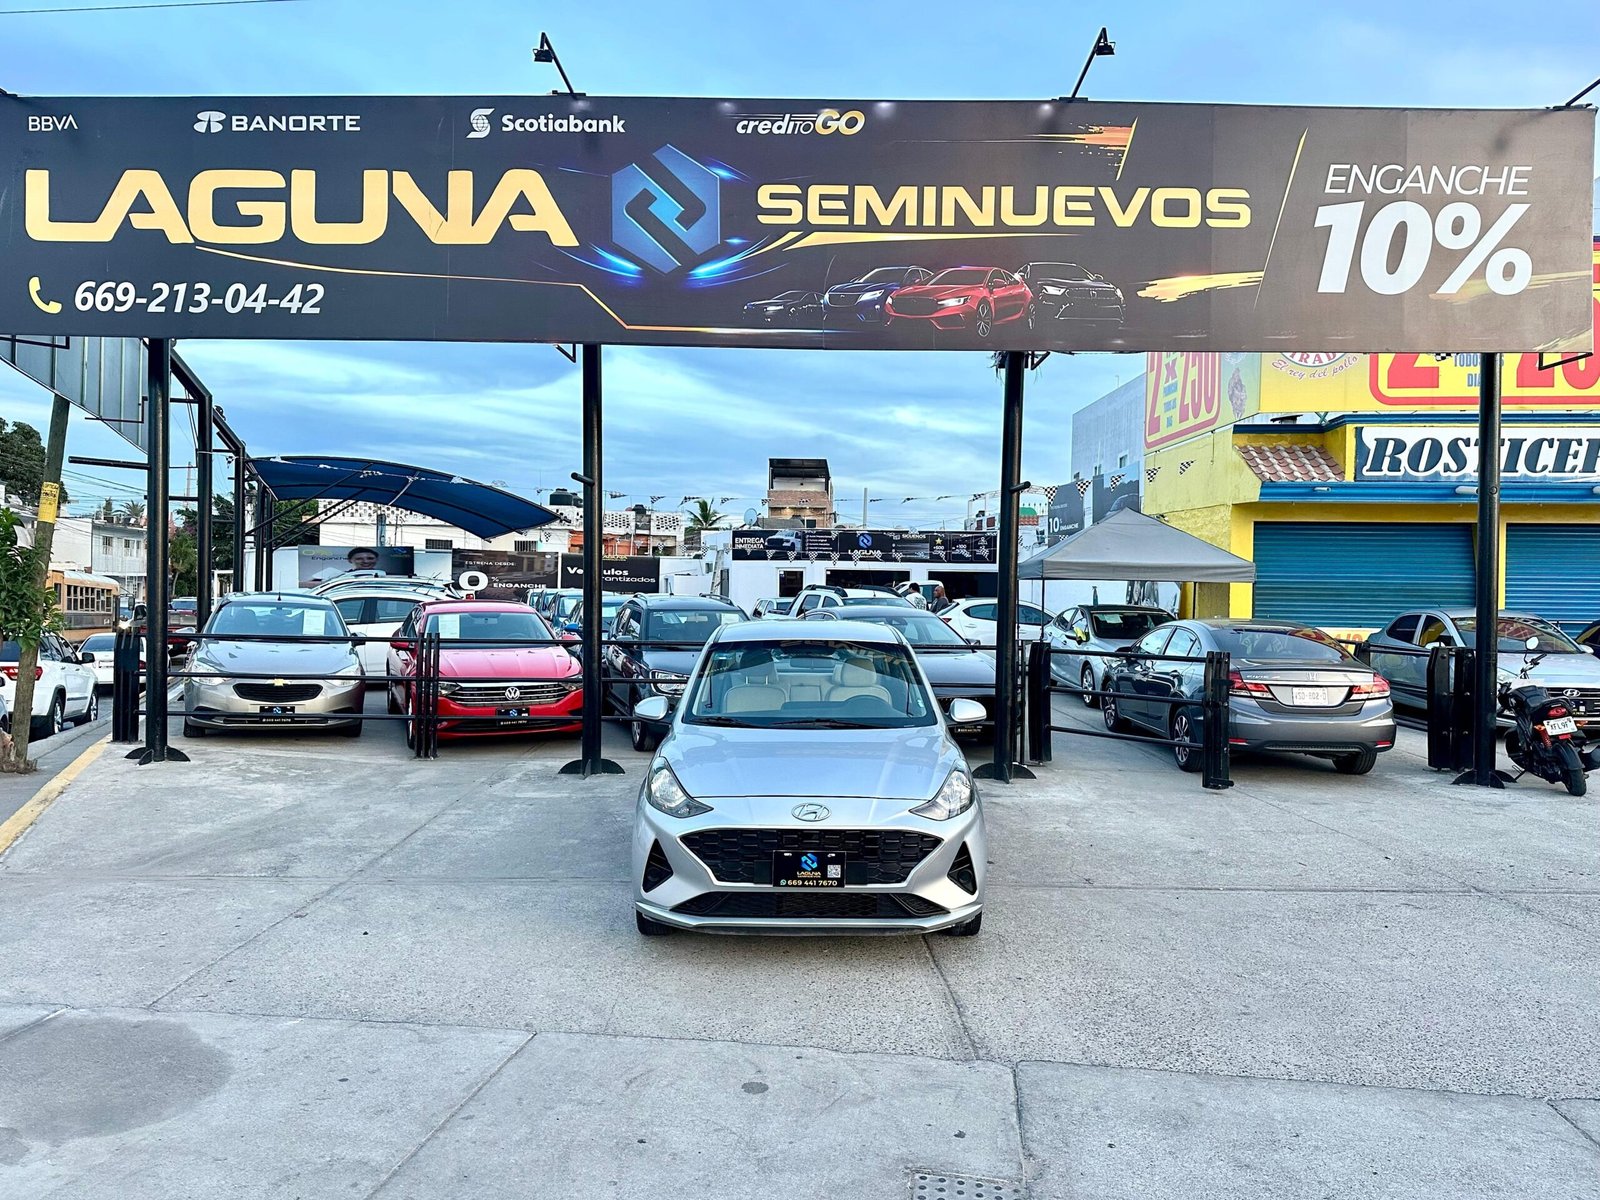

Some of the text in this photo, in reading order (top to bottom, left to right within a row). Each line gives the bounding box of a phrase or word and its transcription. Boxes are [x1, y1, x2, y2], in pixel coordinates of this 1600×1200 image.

[28, 114, 78, 131] BBVA
[231, 115, 361, 131] BANORTE
[501, 114, 626, 134] Scotiabank
[1324, 164, 1533, 195] ENGANCHE
[25, 168, 580, 246] LAGUNA
[756, 184, 1252, 229] SEMINUEVOS
[1313, 200, 1533, 296] 10%
[75, 281, 325, 314] 669-213-04-42
[1289, 368, 1305, 380] rey
[1309, 368, 1328, 378] del
[1332, 354, 1359, 376] pollo
